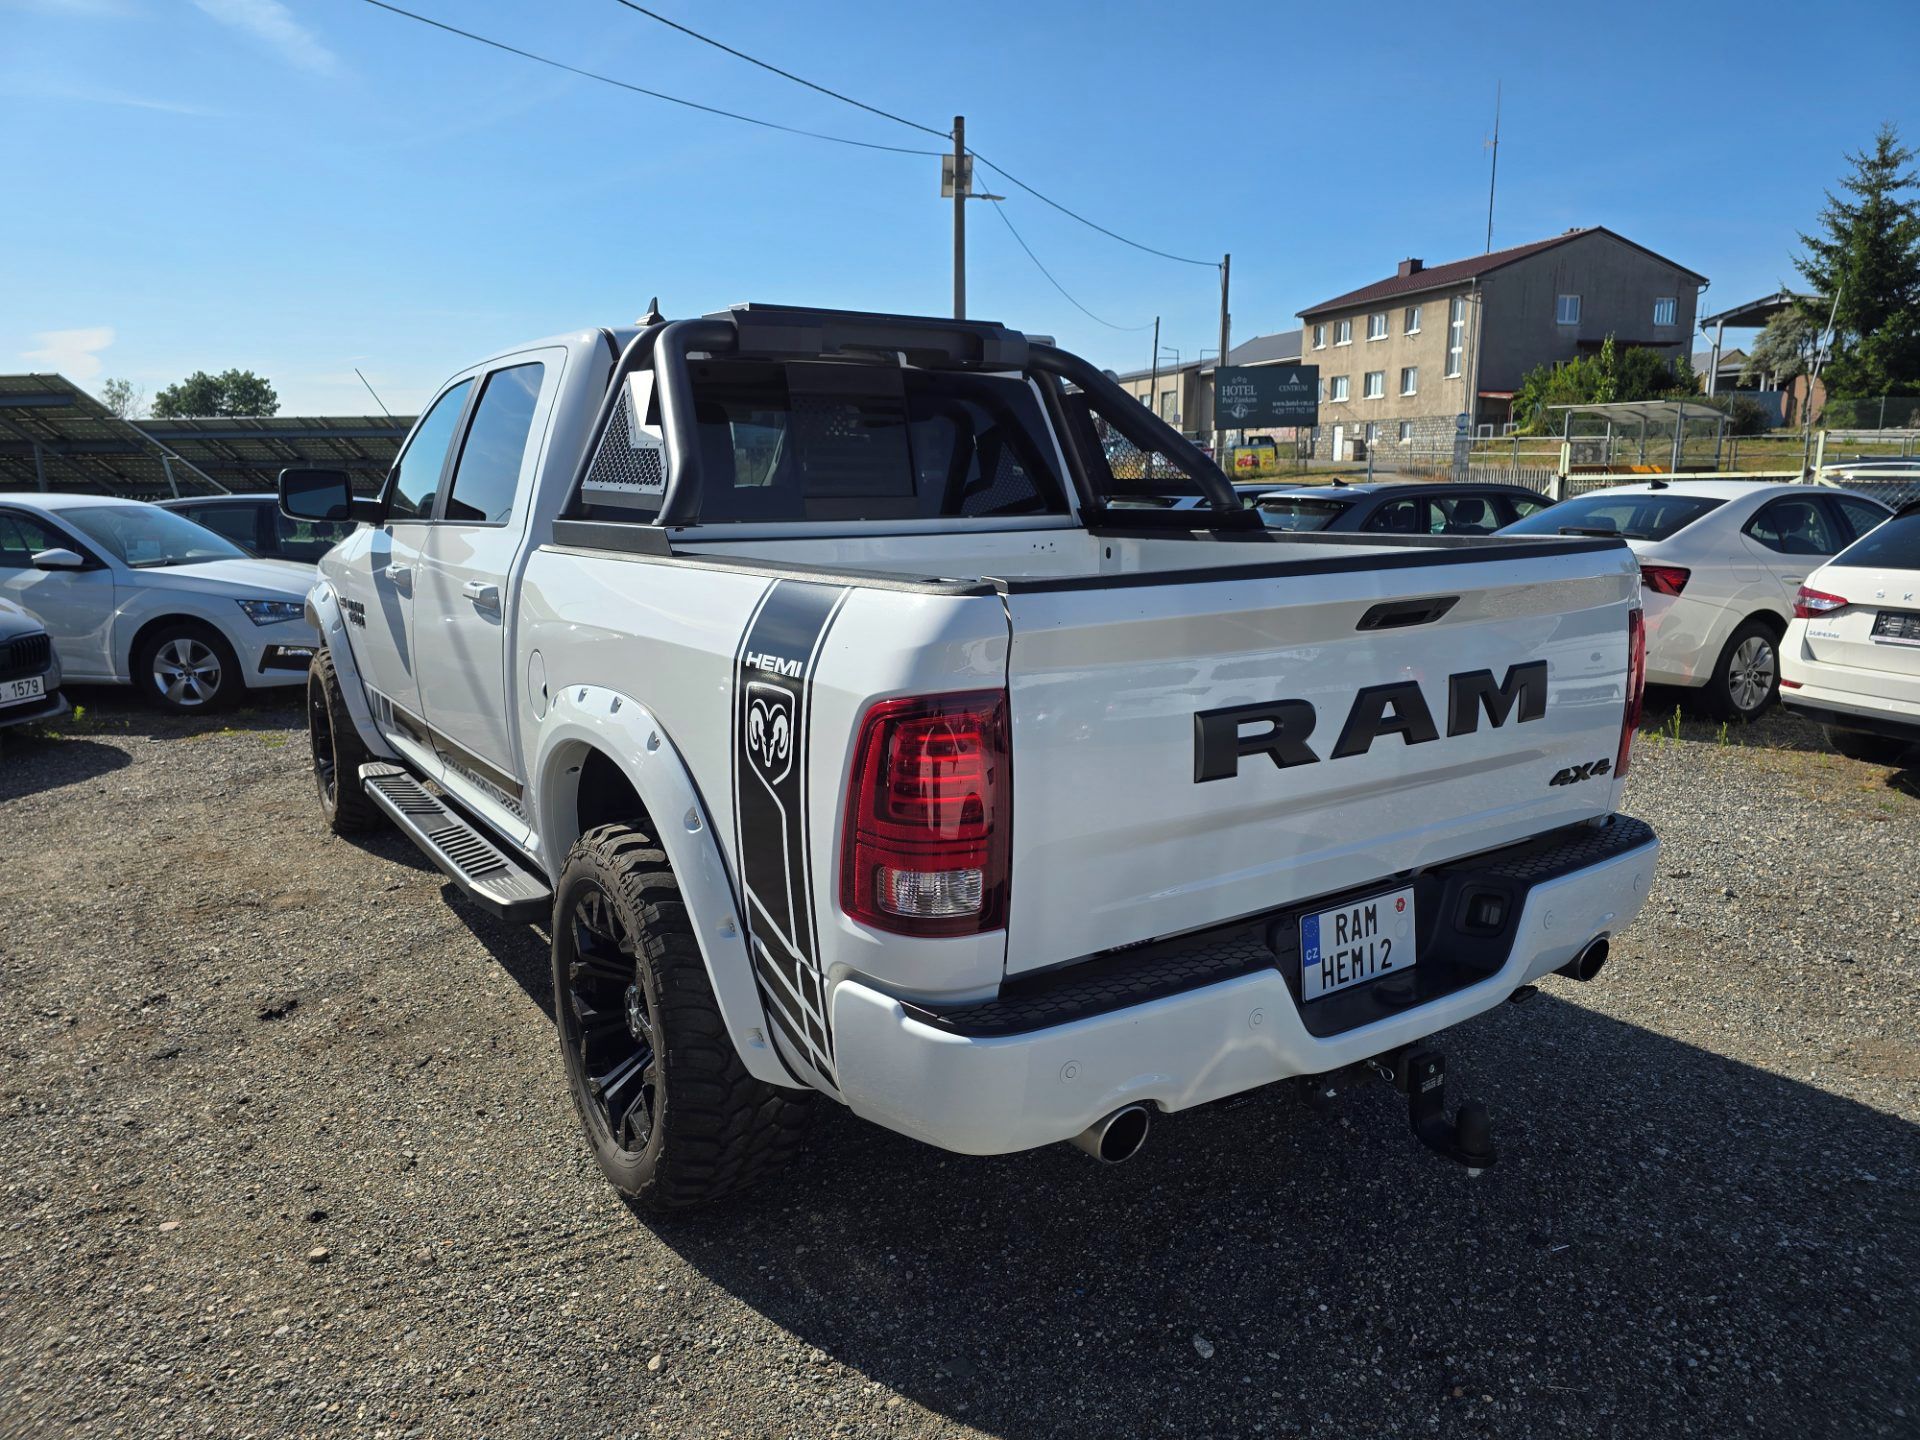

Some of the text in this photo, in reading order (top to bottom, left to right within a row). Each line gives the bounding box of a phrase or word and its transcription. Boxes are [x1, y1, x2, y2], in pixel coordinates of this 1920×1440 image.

[1222, 384, 1257, 396] HOTEL
[1278, 384, 1309, 392] CENTRUM
[745, 651, 804, 679] HEMI
[11, 679, 39, 698] 1579
[1193, 659, 1549, 784] RAM
[1335, 903, 1378, 947] RAM
[1305, 947, 1319, 961] CZ
